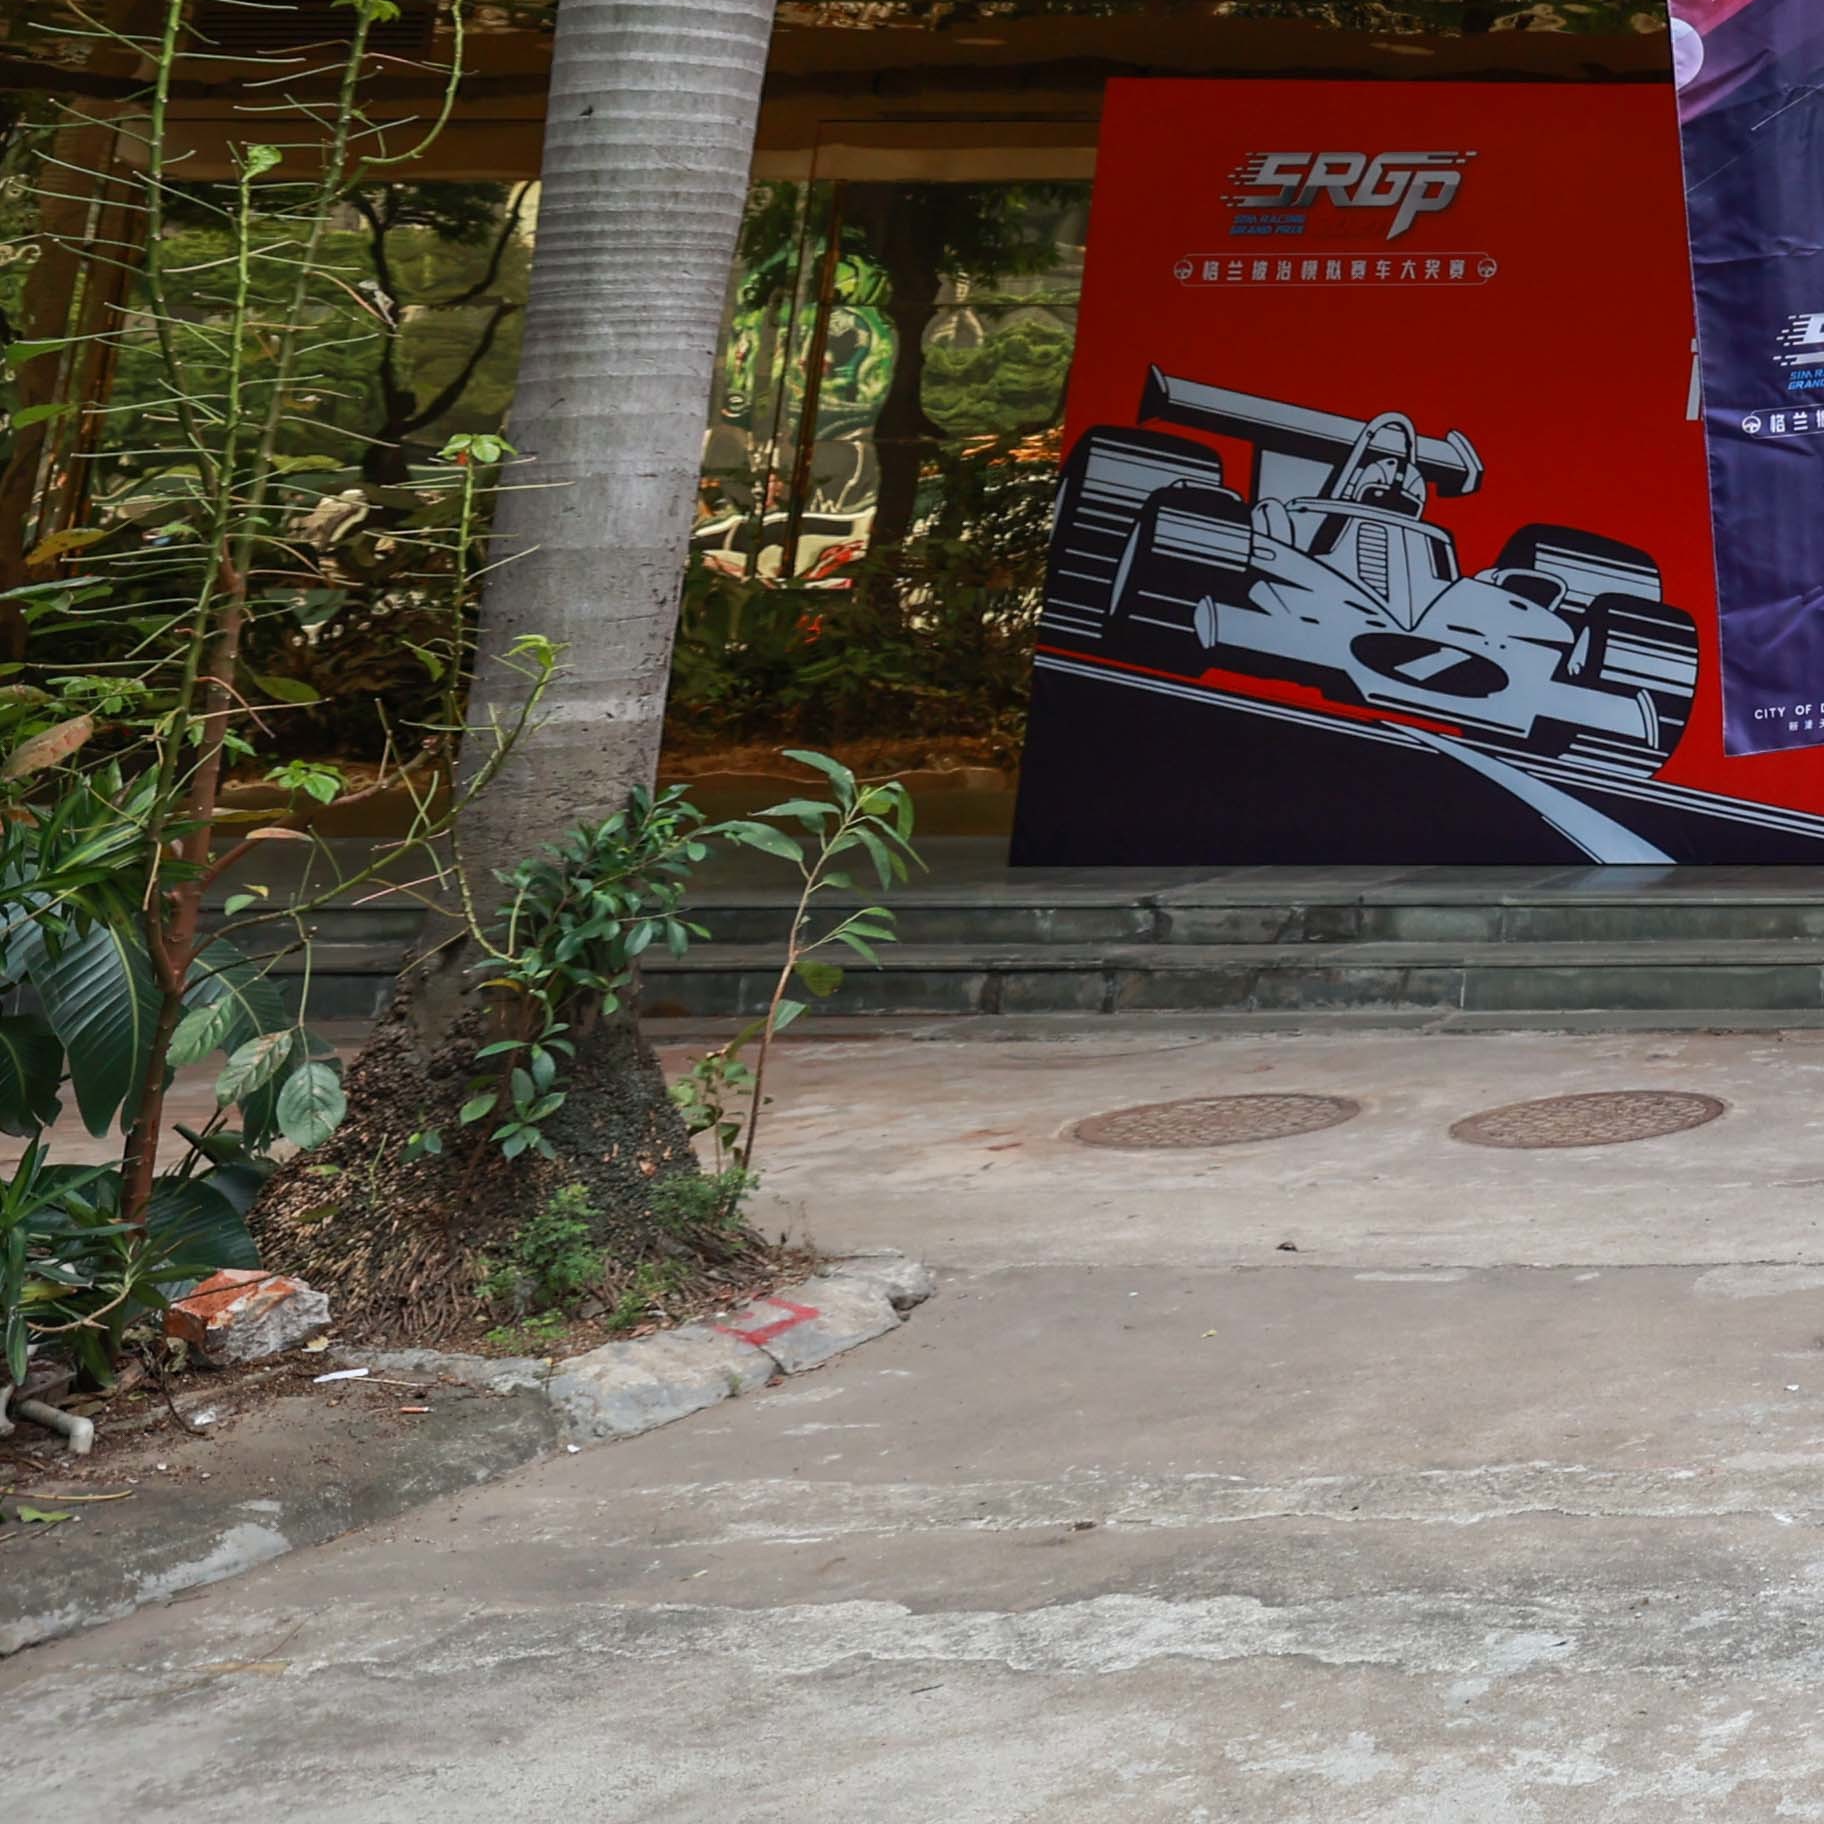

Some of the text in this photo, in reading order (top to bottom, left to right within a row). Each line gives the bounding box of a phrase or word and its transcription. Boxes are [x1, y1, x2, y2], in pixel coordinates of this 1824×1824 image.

[1222, 151, 1475, 241] SRGP
[1202, 259, 1466, 282] 格兰披治模拟赛车大奖赛
[1754, 705, 1786, 720] CITY
[1794, 703, 1813, 716] OF
